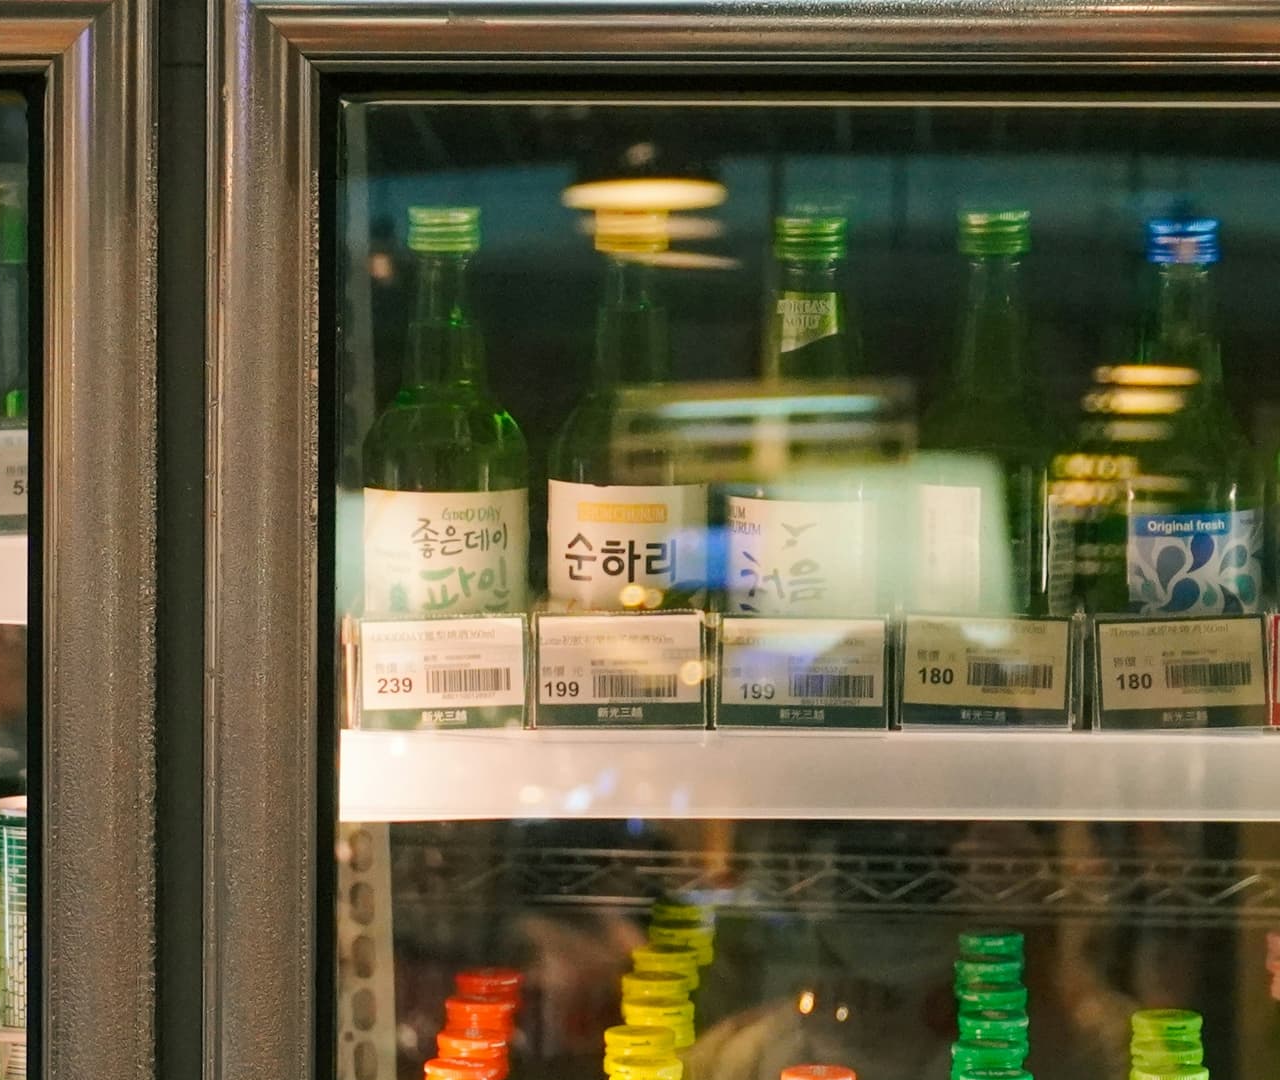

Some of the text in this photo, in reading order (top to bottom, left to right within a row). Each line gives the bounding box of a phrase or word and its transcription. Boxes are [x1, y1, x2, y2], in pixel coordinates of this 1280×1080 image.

[12, 479, 26, 496] 5
[1147, 518, 1225, 534] Original fresh
[411, 517, 508, 559] 좋은데이
[565, 531, 678, 584] 순하리
[418, 555, 510, 613] 파인
[917, 667, 955, 685] 180
[1115, 673, 1153, 691] 180
[376, 677, 414, 696] 239
[543, 681, 580, 698] 199
[739, 682, 776, 701] 199
[421, 710, 468, 723] 新光三越
[596, 706, 644, 720] 新光三越
[779, 708, 826, 722] 新光三越
